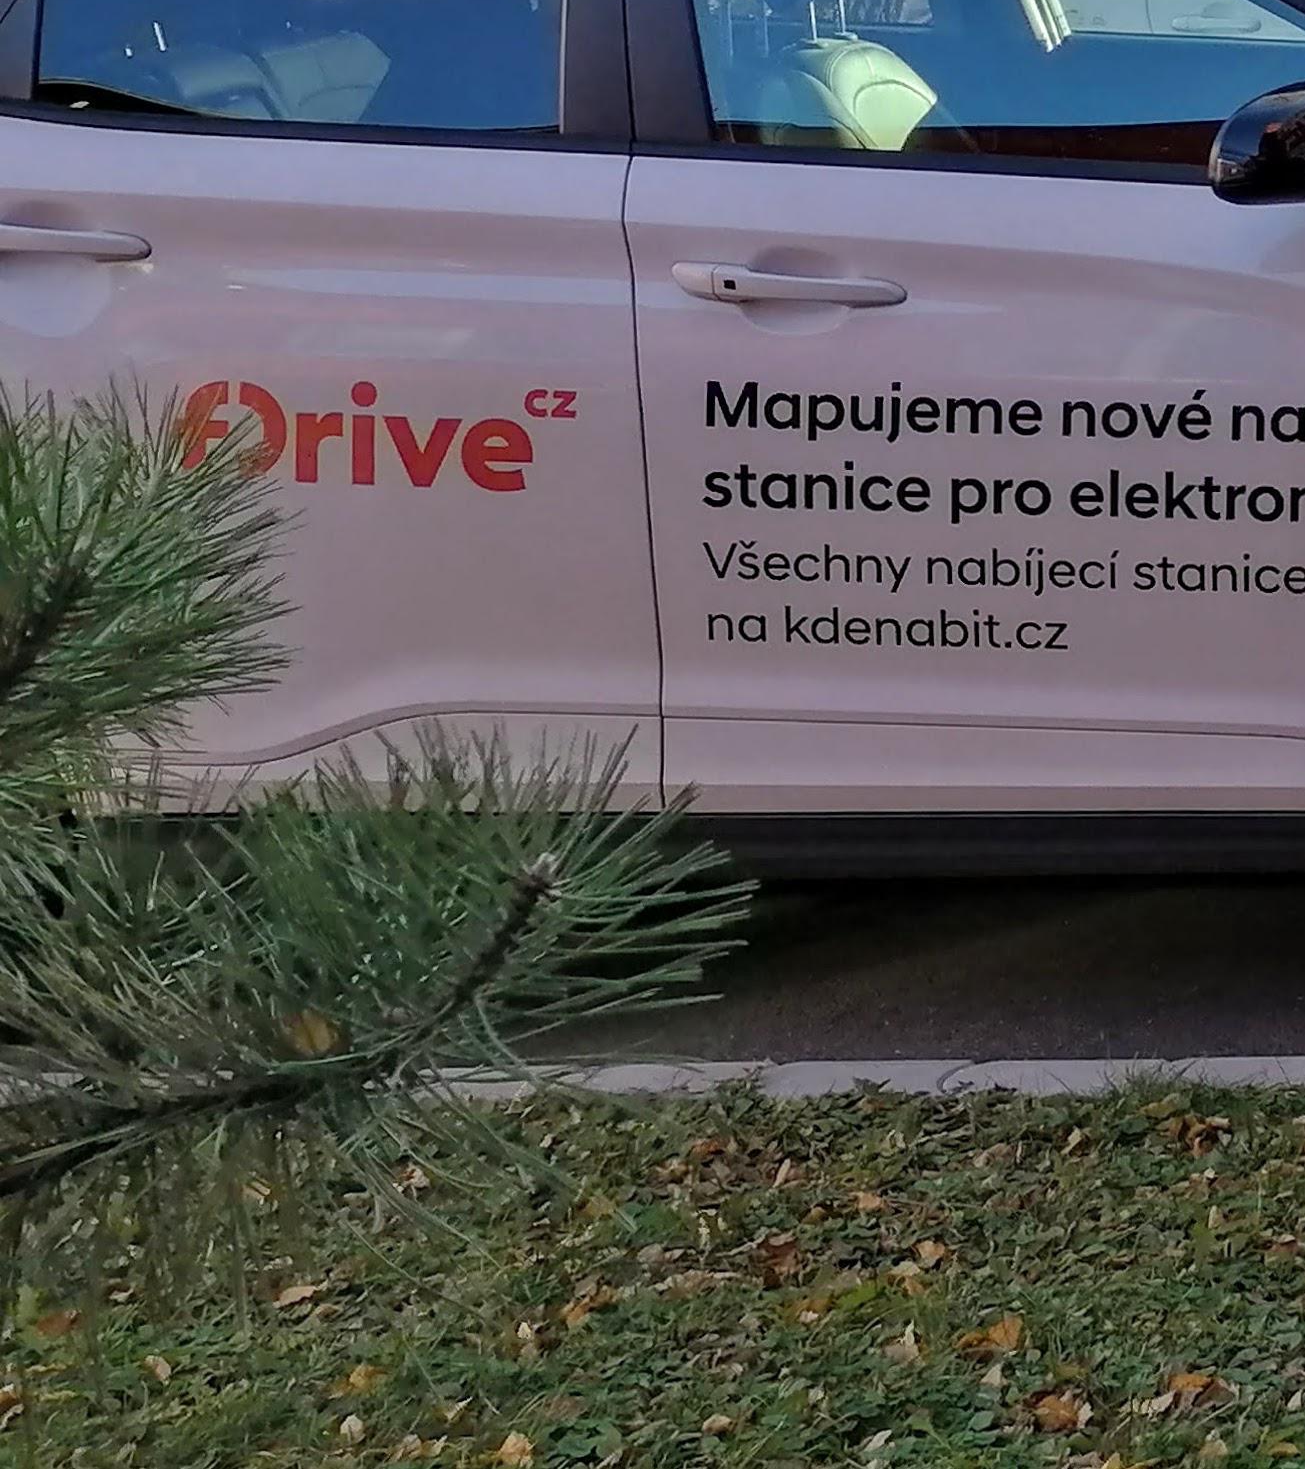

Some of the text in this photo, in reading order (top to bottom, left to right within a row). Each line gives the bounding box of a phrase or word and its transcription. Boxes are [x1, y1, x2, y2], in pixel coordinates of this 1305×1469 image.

[705, 380, 1043, 444] Mapujeme
[1061, 389, 1212, 441] nové
[701, 460, 931, 513] stanice
[950, 477, 1052, 525] pro
[702, 539, 912, 594] Všechny
[926, 547, 1120, 597] nabíjecí
[707, 605, 1069, 650] na kdenabit.cz
